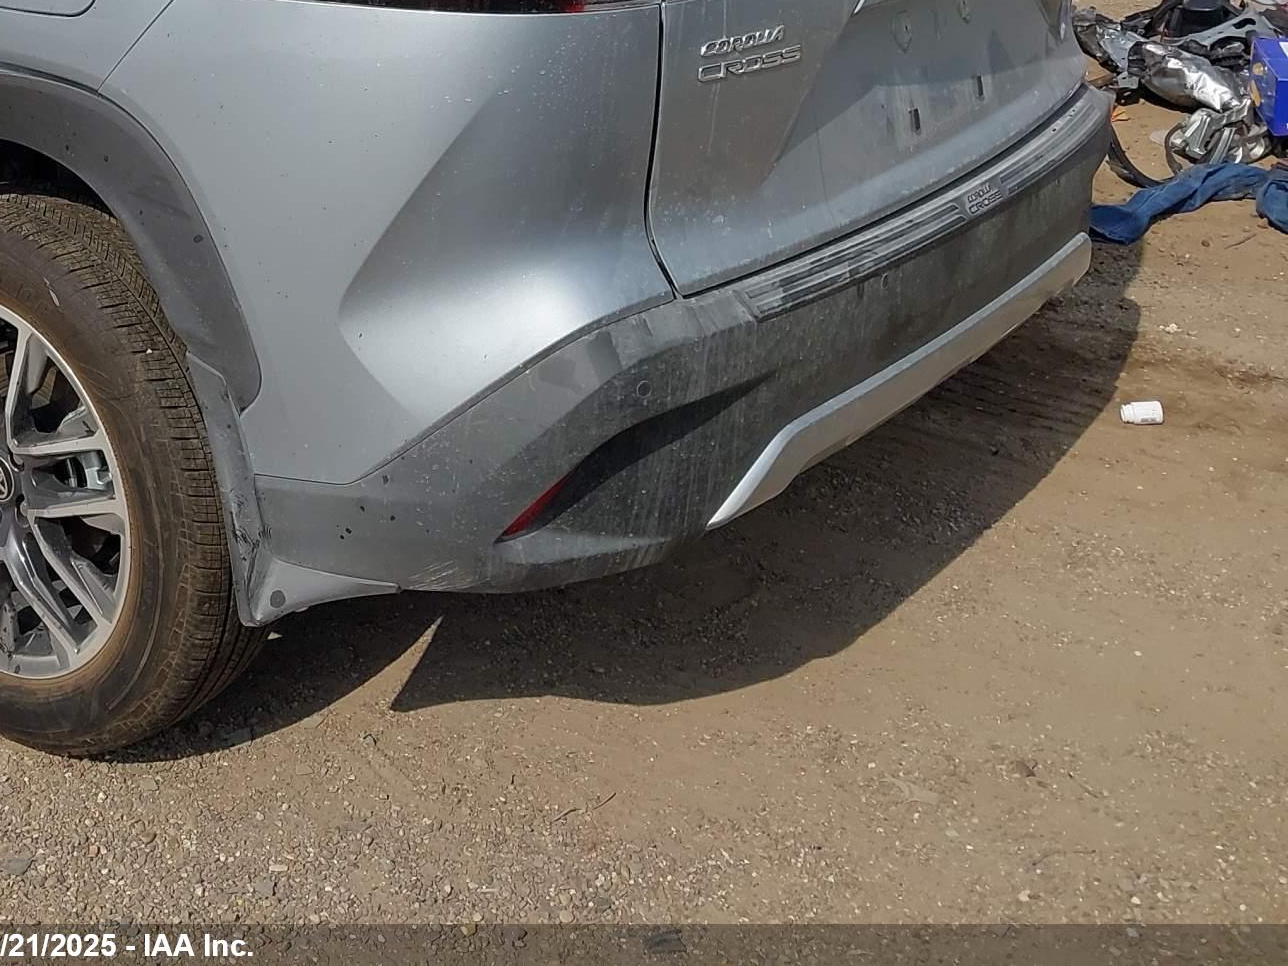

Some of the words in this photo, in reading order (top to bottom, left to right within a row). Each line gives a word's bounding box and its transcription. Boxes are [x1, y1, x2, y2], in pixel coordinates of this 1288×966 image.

[700, 23, 785, 58] COROLLA
[697, 44, 801, 83] CROSS
[968, 189, 1003, 215] CROSS
